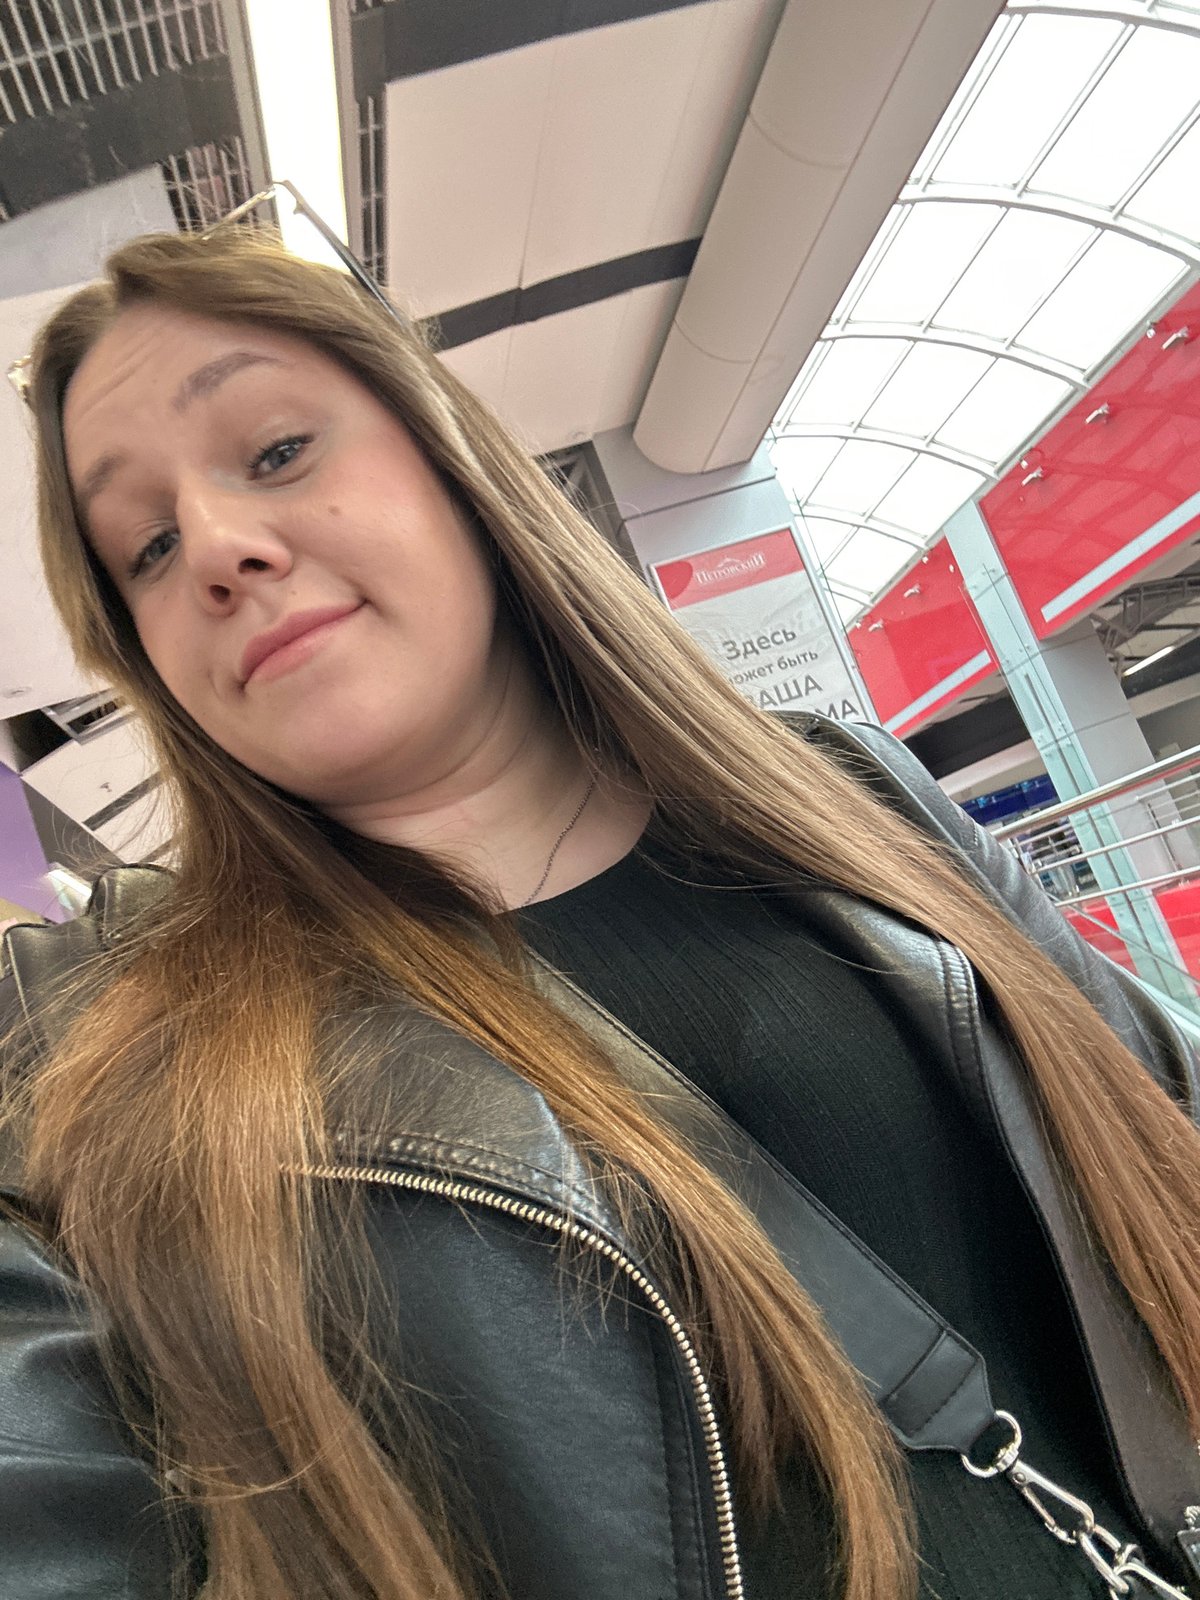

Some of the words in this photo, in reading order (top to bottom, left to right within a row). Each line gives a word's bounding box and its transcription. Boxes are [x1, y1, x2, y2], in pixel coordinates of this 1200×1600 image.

[722, 628, 796, 660] Здесь
[730, 663, 774, 684] ожет
[777, 651, 819, 670] быть
